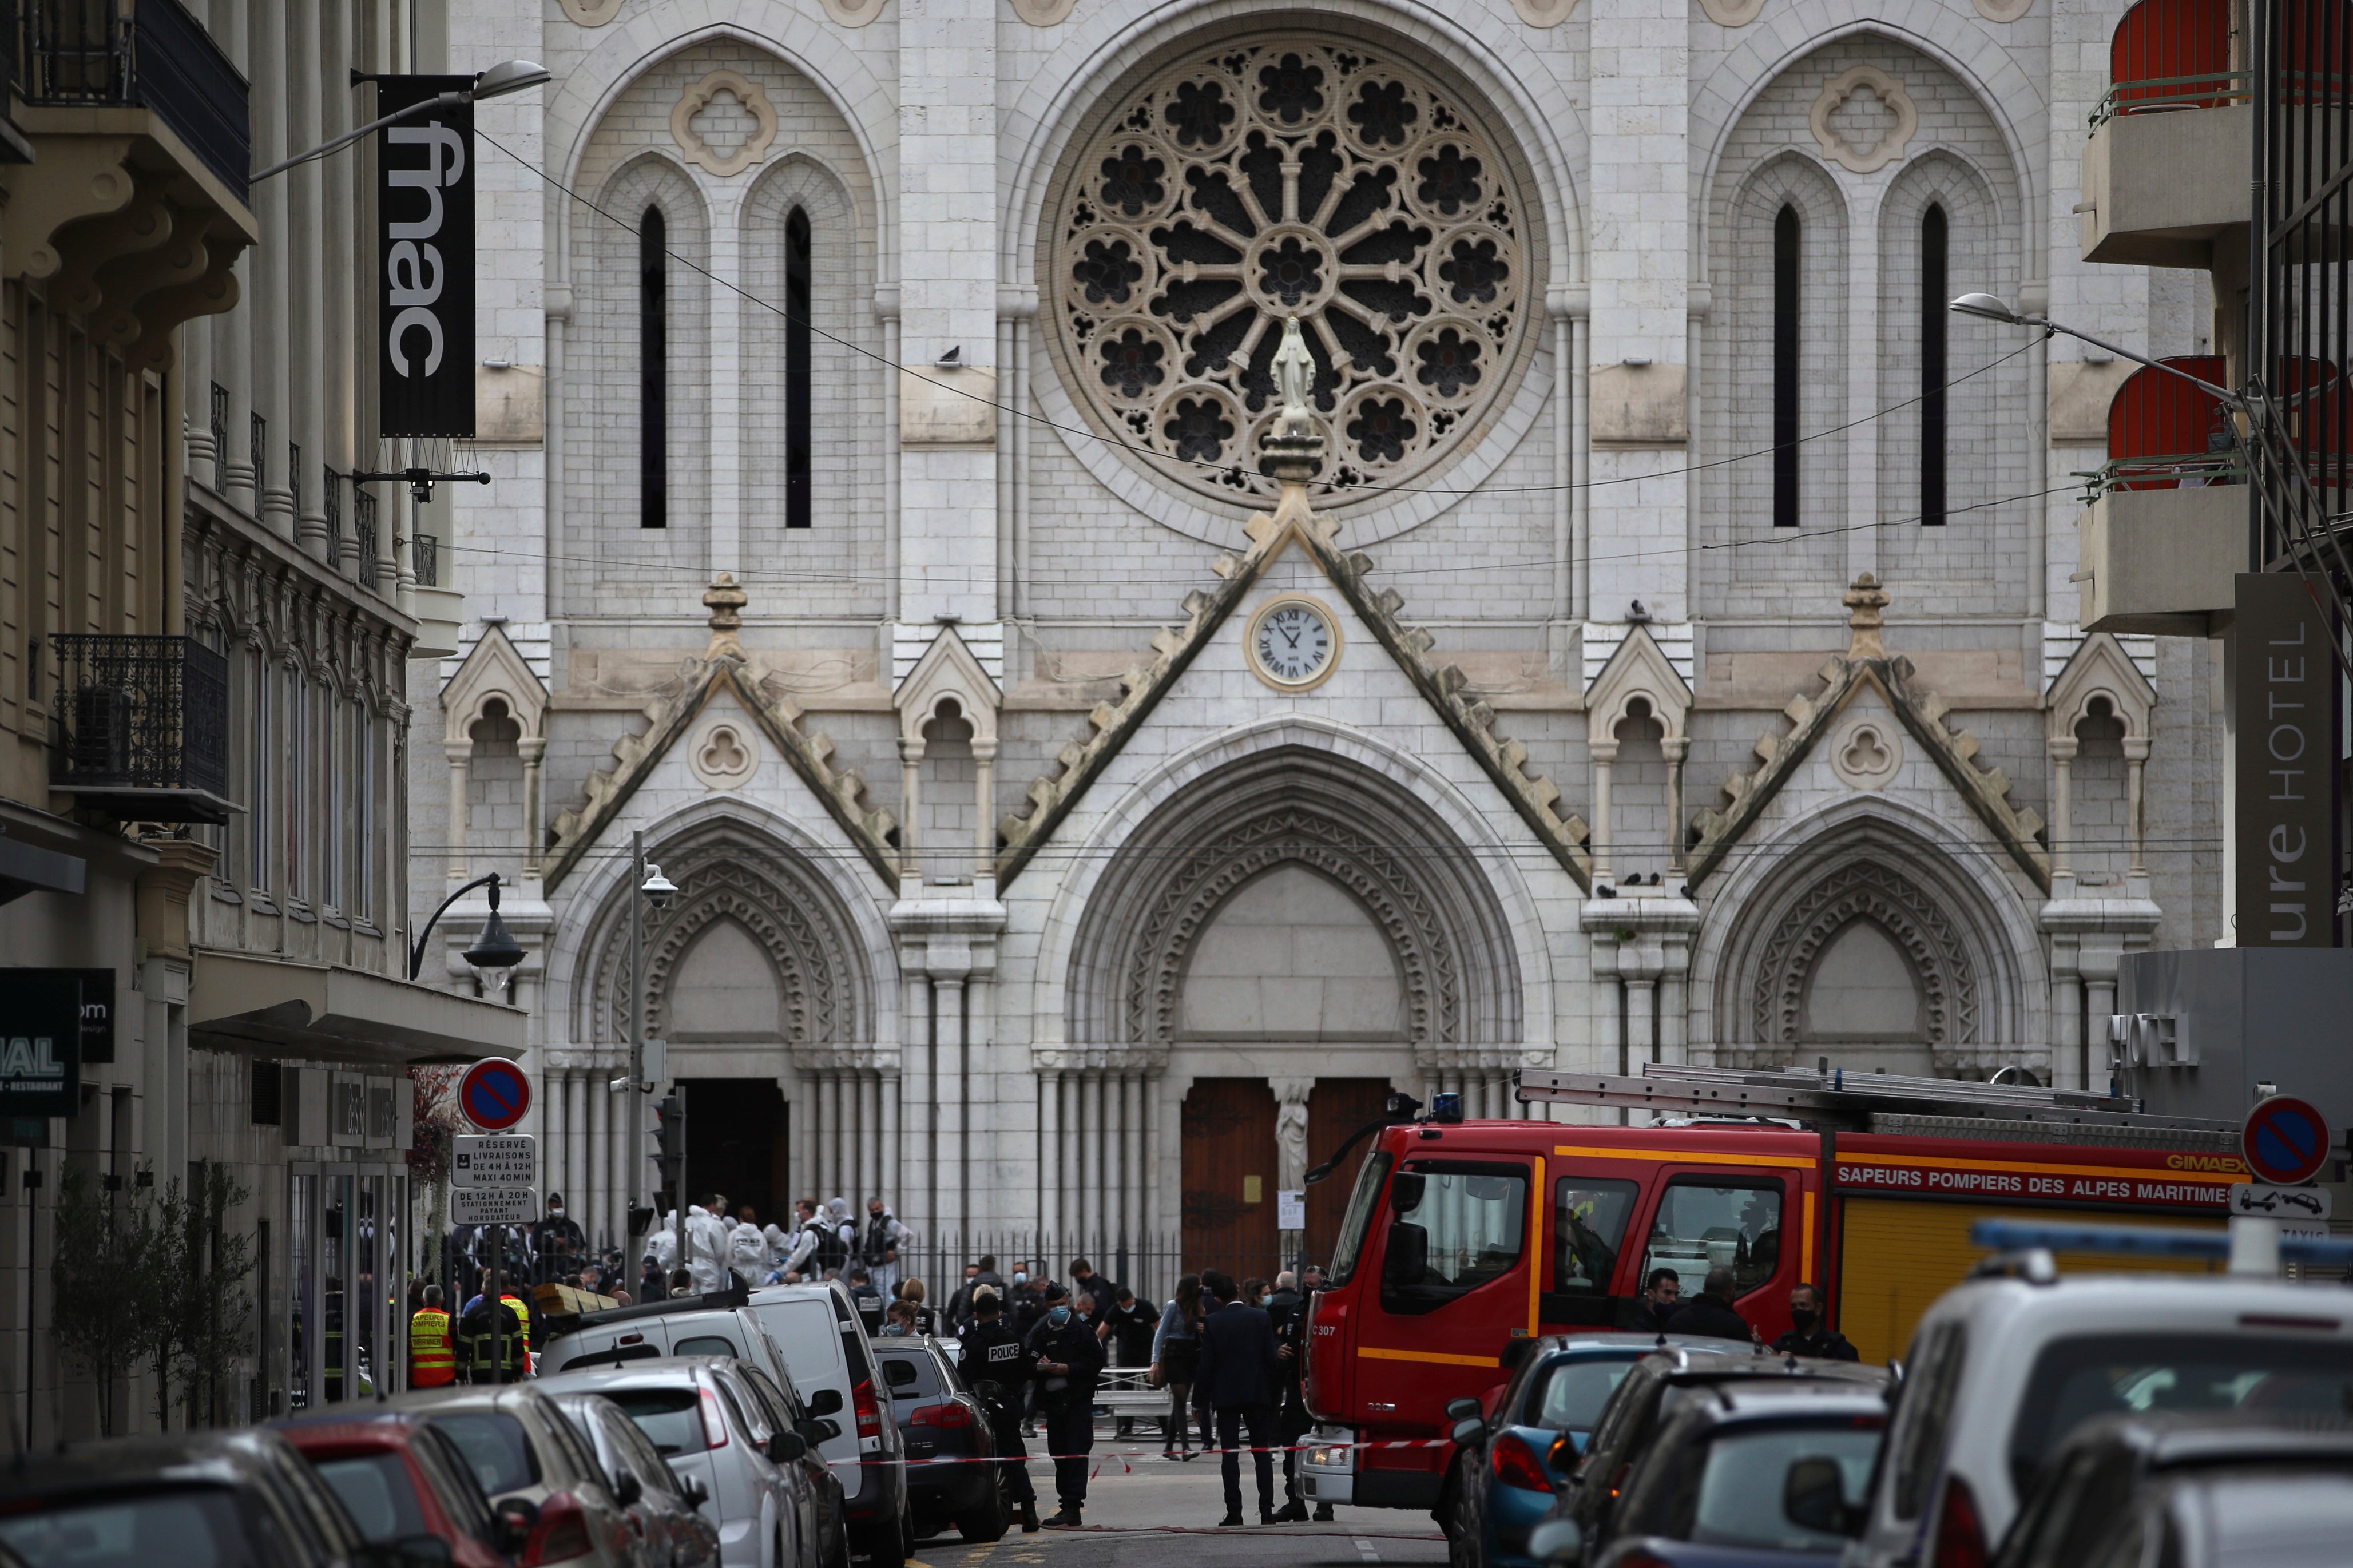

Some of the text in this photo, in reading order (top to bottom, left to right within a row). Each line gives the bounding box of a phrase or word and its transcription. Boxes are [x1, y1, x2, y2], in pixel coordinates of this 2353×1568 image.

[388, 120, 465, 378] fnac
[2269, 622, 2305, 799] HOTEL
[0, 1037, 64, 1077] AL
[10, 1081, 63, 1091] RESTAURANT
[479, 1140, 526, 1148] RÉSERVÉ
[505, 1161, 510, 1170] À
[2166, 1155, 2249, 1173] GIMAEX
[1838, 1167, 1921, 1185] SAPEURS
[1929, 1172, 2021, 1191] POMPIERS
[2029, 1178, 2064, 1193] DES
[2072, 1181, 2130, 1197] ALPES
[499, 1190, 503, 1199] À
[1319, 1325, 1336, 1336] 307
[991, 1345, 1018, 1360] POLICE
